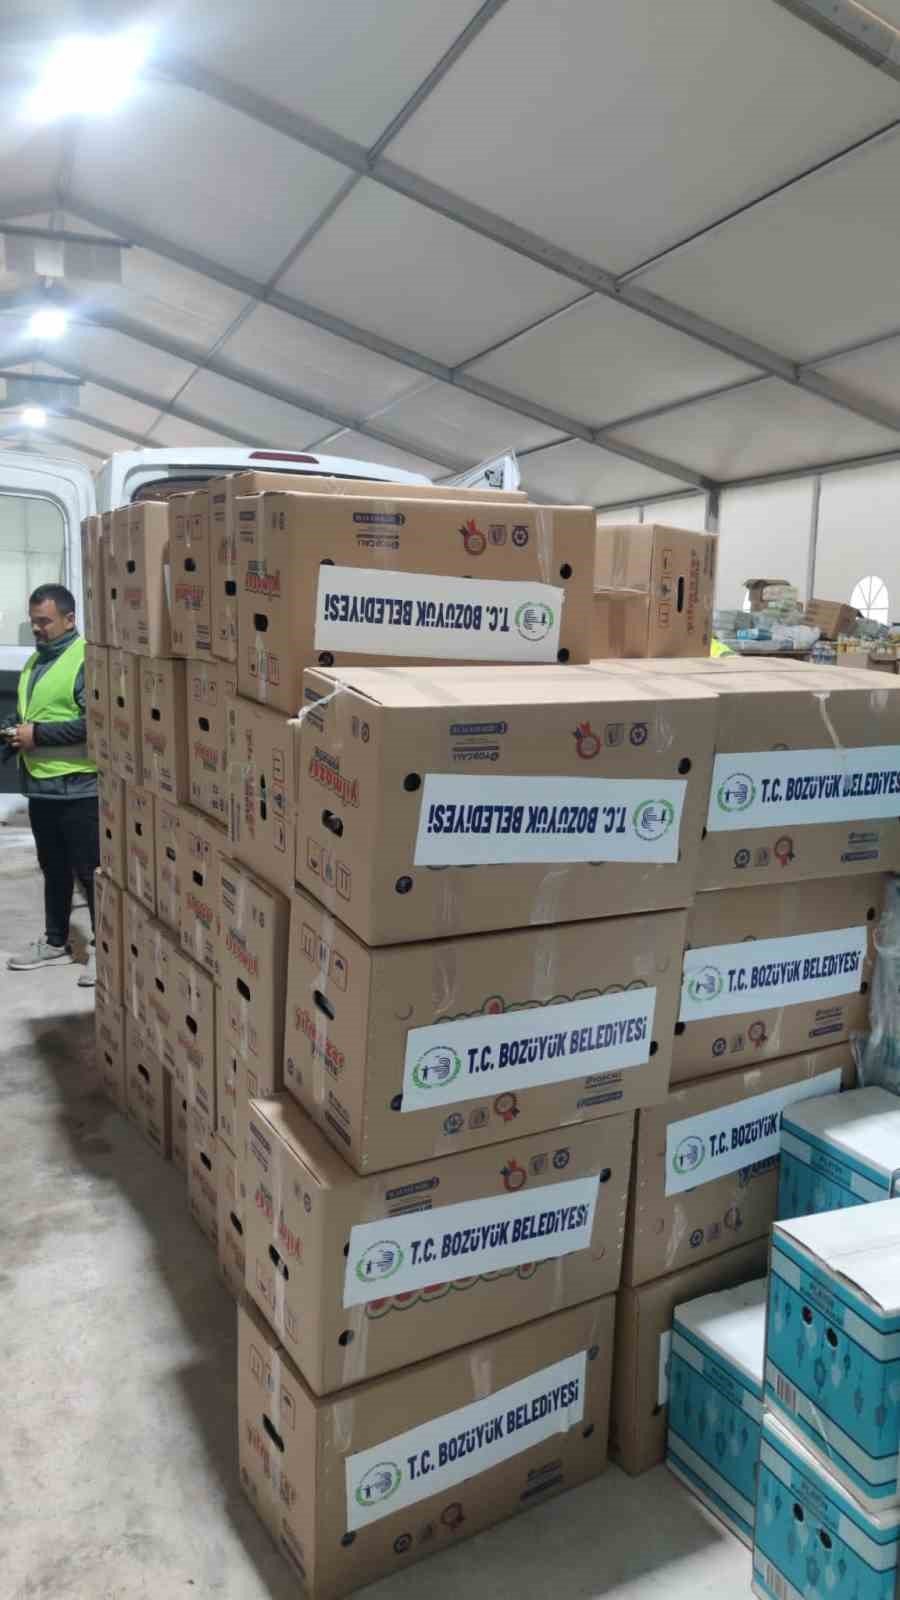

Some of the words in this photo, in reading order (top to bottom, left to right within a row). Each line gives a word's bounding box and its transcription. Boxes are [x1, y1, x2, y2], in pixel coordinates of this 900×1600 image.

[416, 601, 482, 631] BOZÜYÜK
[486, 606, 510, 632] T.C.
[761, 777, 783, 803] T.C.
[785, 774, 843, 802] BOZÜYÜK
[525, 805, 599, 834] BOZÜYÜK
[601, 806, 627, 834] T.C.
[727, 968, 748, 993] T.C.
[750, 959, 802, 989] BOZÜYÜK
[467, 1047, 495, 1074] T.C.
[498, 1031, 567, 1069] BOZÜYÜK
[709, 1131, 729, 1158] T.C.
[731, 1112, 778, 1148] BOZÜYÜK
[410, 1239, 437, 1265] T.C.
[441, 1220, 511, 1259] BOZÜYÜK
[407, 1450, 434, 1480] T.C.
[438, 1415, 504, 1467] BOZÜYÜK
